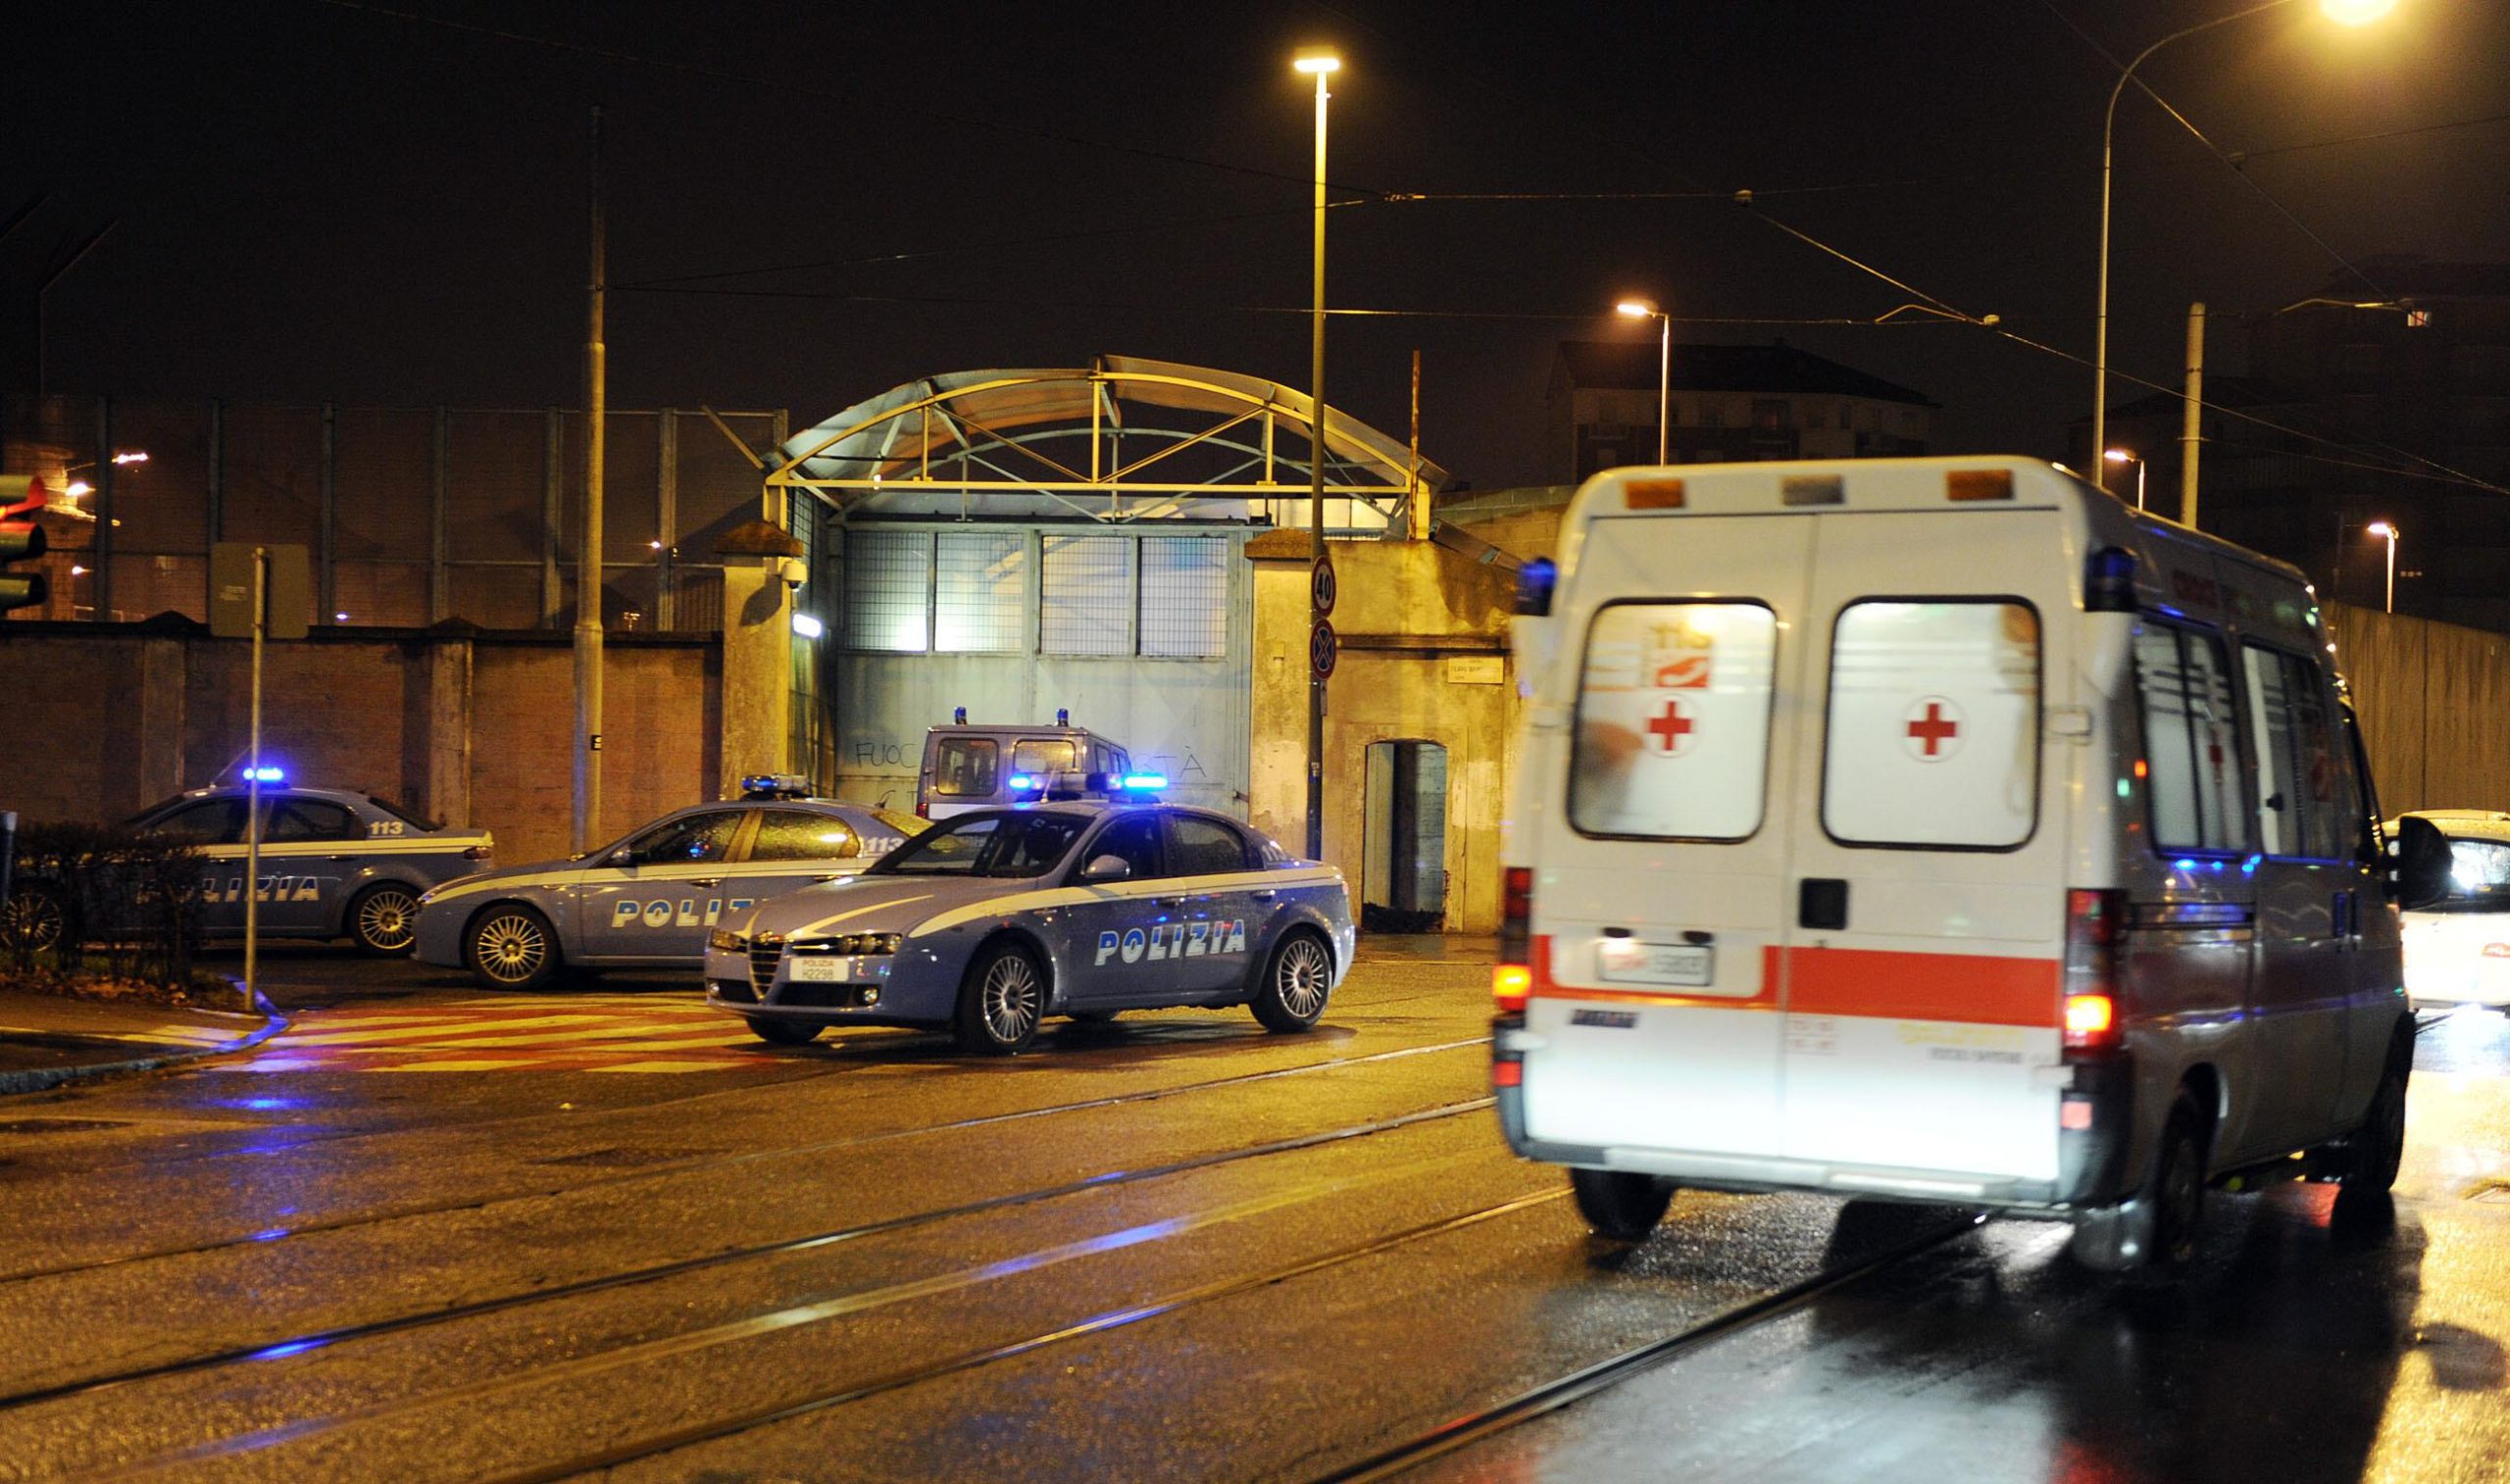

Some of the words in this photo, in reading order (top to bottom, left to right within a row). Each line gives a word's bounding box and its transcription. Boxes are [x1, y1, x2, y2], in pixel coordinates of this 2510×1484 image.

[1316, 571, 1332, 601] 40
[856, 742, 919, 769] FUOC
[370, 820, 403, 835] 113
[1093, 917, 1246, 966] POLIZIA
